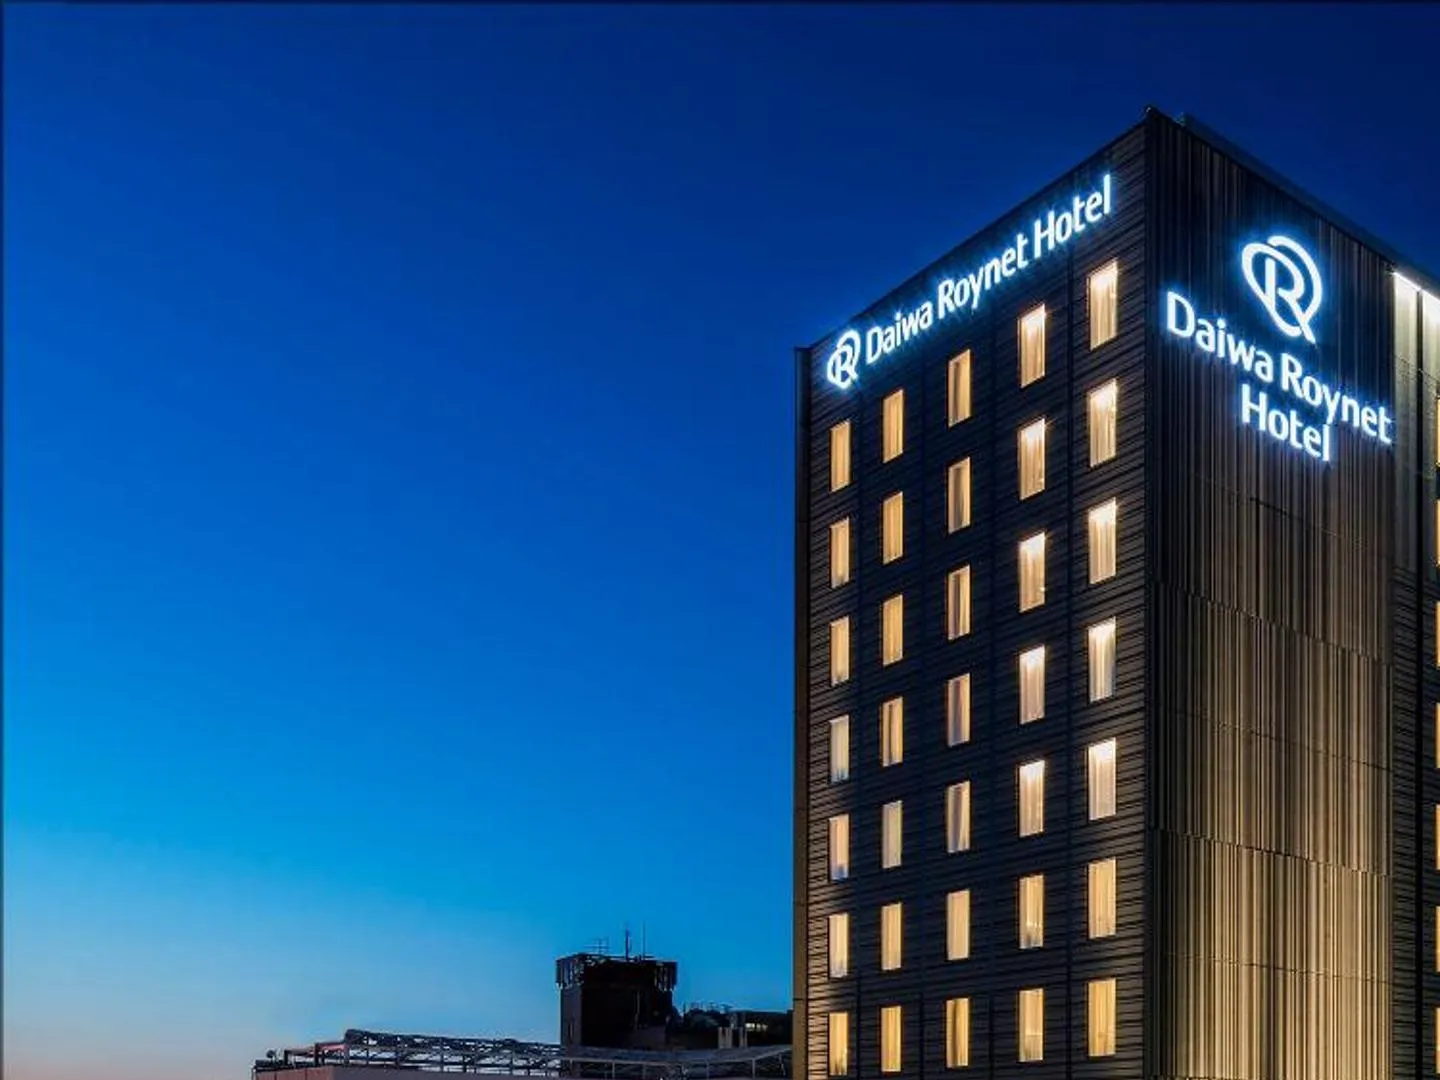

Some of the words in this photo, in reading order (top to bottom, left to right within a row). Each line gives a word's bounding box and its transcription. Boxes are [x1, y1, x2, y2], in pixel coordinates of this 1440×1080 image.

[865, 310, 932, 365] Daiwa
[938, 233, 1028, 319] Roynet
[1034, 174, 1111, 259] Hotel
[1167, 290, 1274, 382] Daiwa
[1281, 356, 1392, 445] Roynet
[1242, 384, 1331, 462] Hotel
